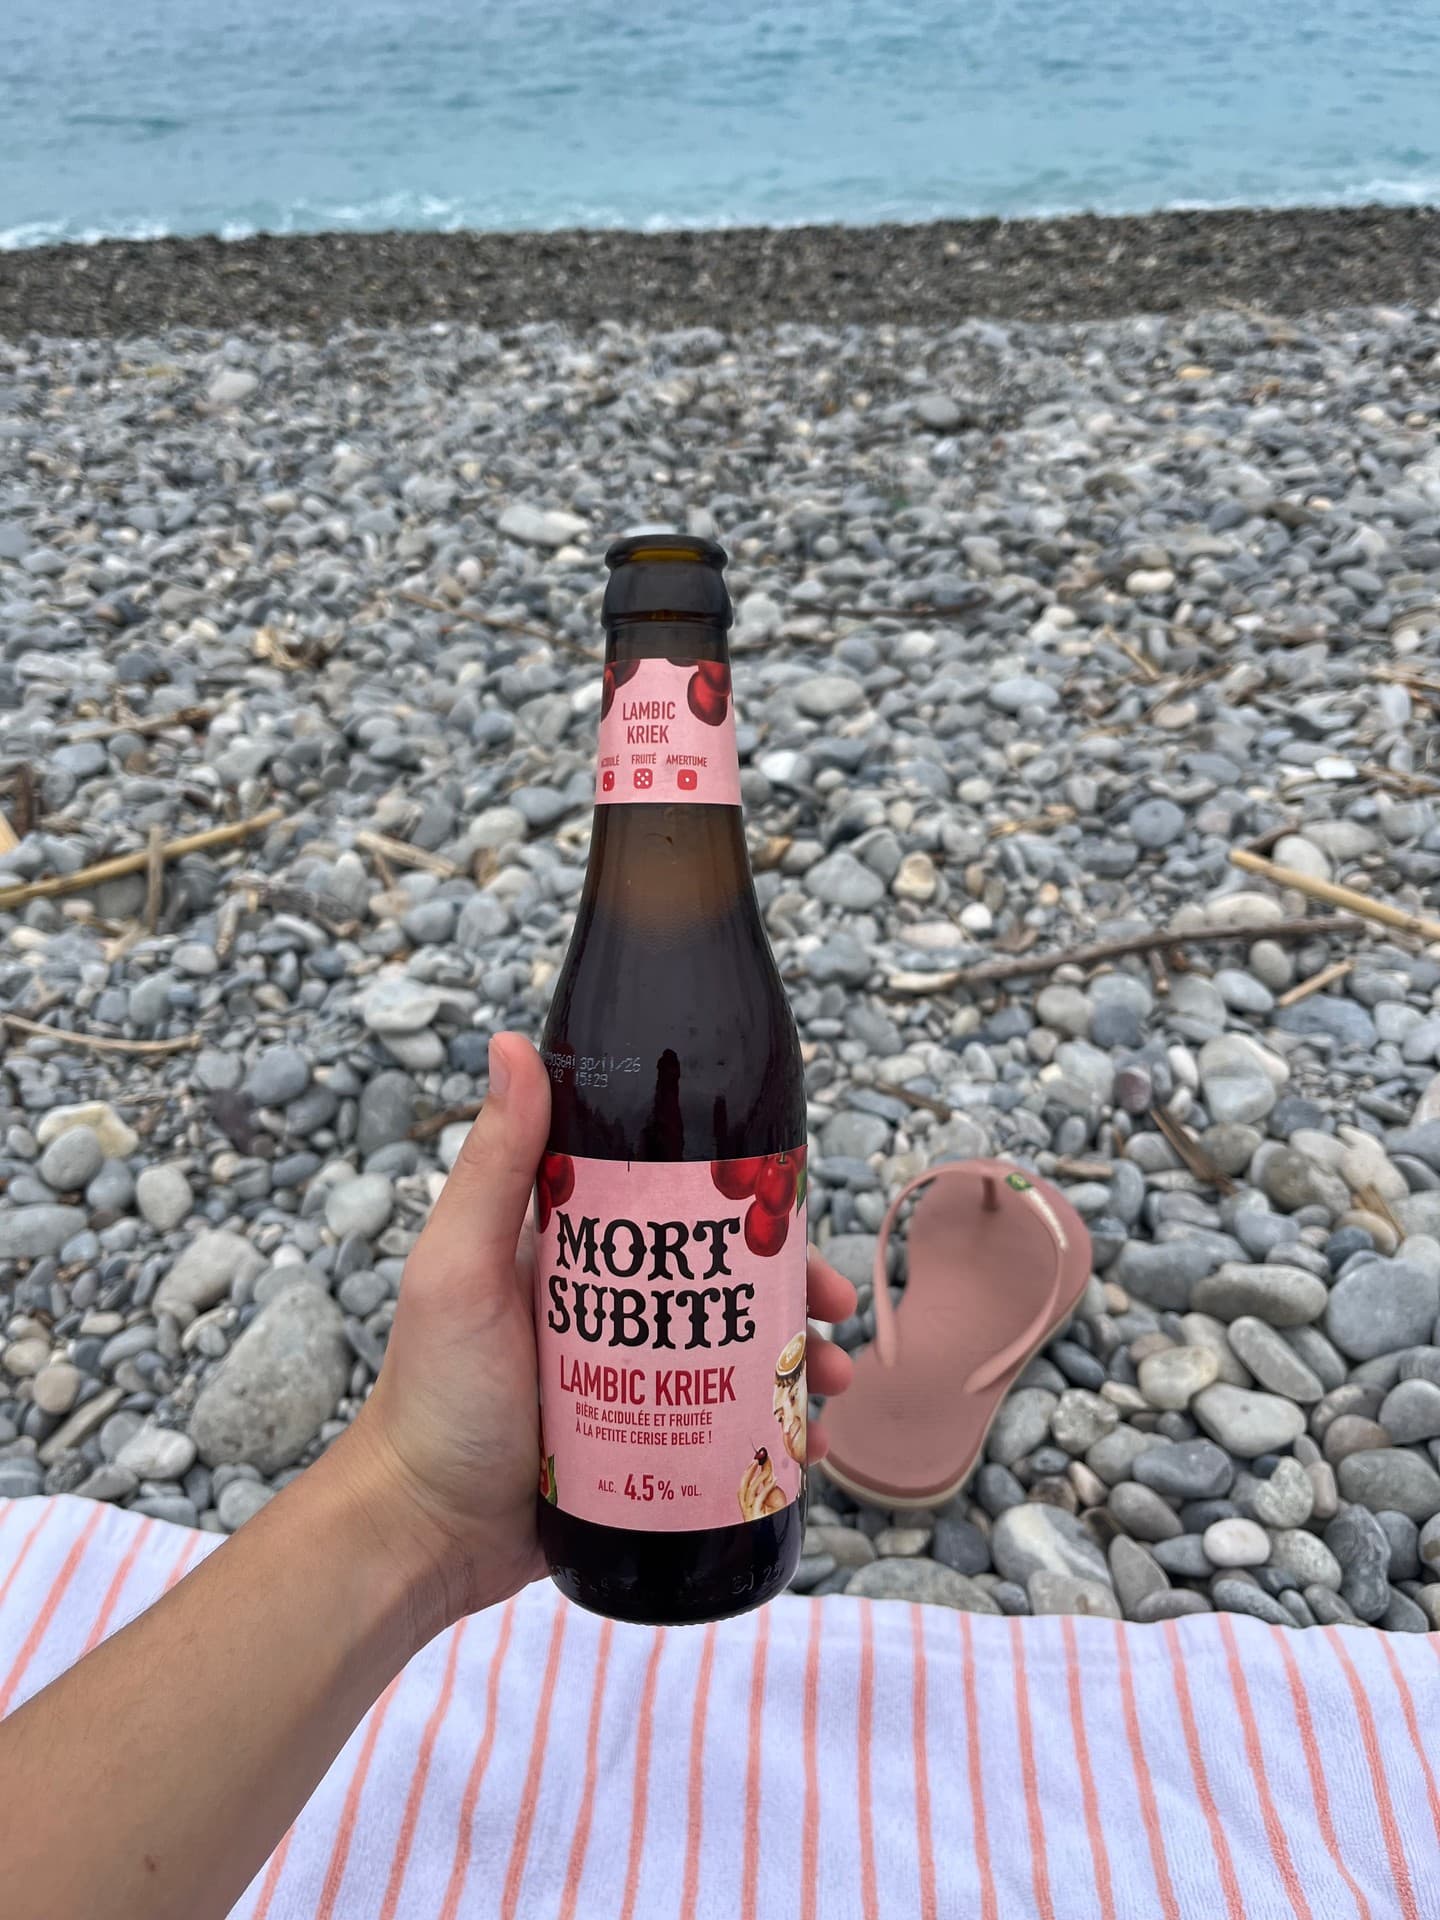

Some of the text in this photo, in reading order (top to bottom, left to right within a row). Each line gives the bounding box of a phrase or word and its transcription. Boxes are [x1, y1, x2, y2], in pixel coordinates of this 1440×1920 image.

[622, 701, 676, 721] LAMBIC
[626, 725, 669, 744] KRIEK
[631, 753, 656, 765] FRUITÉ
[666, 754, 707, 767] AMERTUME
[556, 1210, 741, 1282] MORT
[548, 1275, 755, 1350] SUBITE
[560, 1354, 736, 1406] LAMBIC KRIEK
[576, 1401, 713, 1427] BIÈRE ACIDULÉE ET FRUITÉE
[583, 1422, 593, 1438] LA
[595, 1426, 627, 1444] PETITE
[630, 1431, 668, 1446] CERISE
[671, 1431, 705, 1446] BELGE
[598, 1479, 617, 1494] ALC.
[681, 1485, 702, 1497] VOL.
